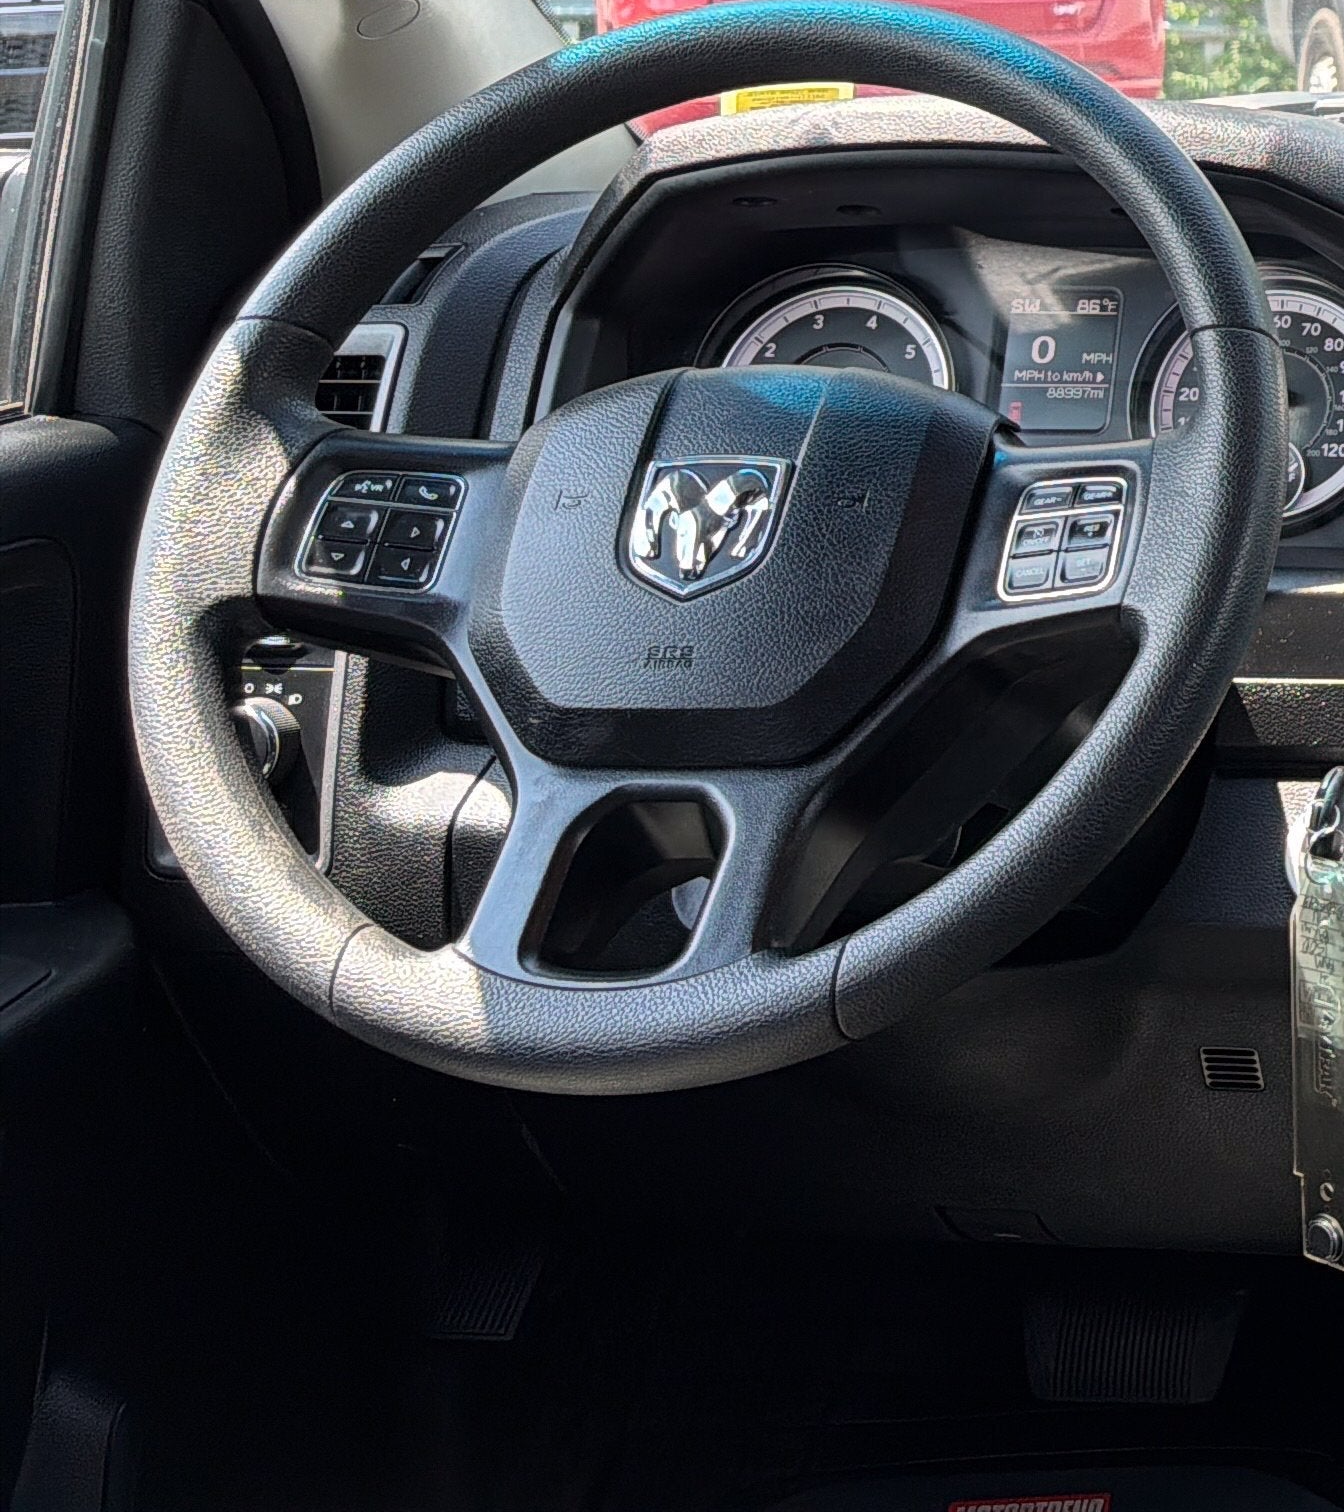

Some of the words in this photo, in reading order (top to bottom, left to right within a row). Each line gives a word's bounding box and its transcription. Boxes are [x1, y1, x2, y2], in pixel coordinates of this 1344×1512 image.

[1011, 298, 1041, 312] SW
[813, 314, 825, 329] 3
[866, 315, 878, 330] 4
[1301, 322, 1321, 336] 70
[764, 342, 777, 358] 2
[904, 344, 917, 359] 5
[1032, 335, 1056, 364] 0
[1082, 352, 1112, 364] MPH
[1324, 338, 1344, 352] 80
[1014, 370, 1044, 382] MPH
[1047, 371, 1060, 382] to
[1063, 370, 1093, 382] km/h
[1179, 387, 1200, 401] 20
[957, 1498, 1104, 1512] RTREND
